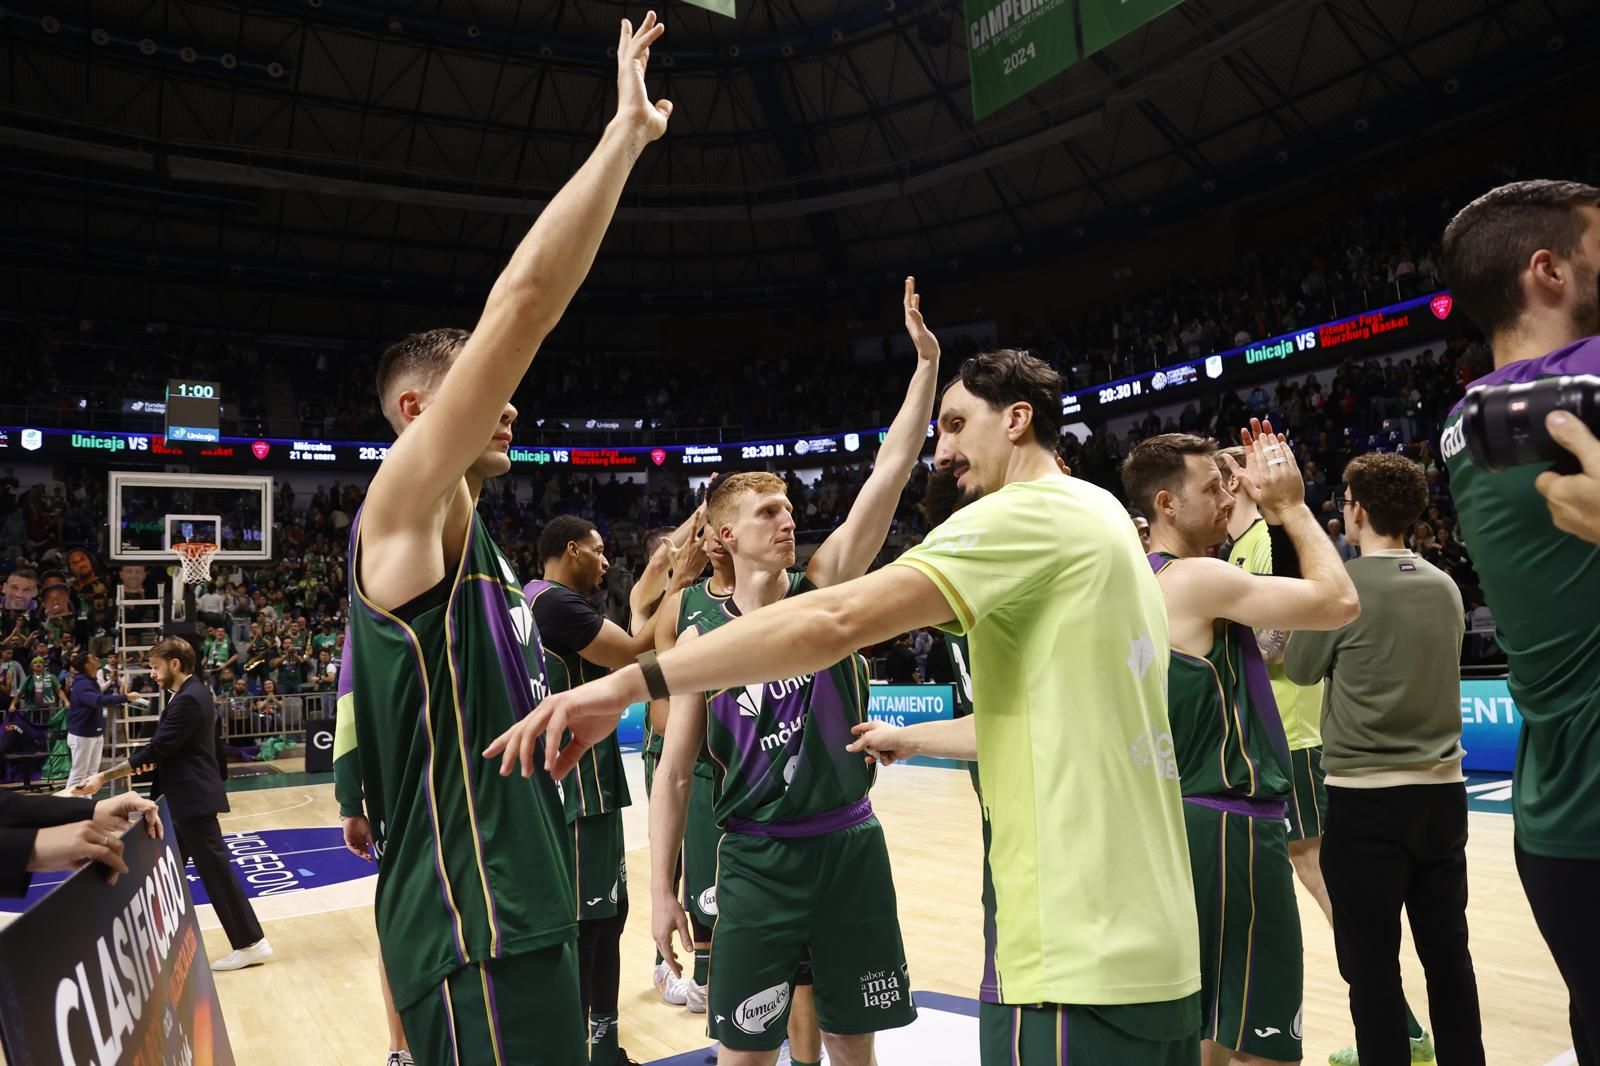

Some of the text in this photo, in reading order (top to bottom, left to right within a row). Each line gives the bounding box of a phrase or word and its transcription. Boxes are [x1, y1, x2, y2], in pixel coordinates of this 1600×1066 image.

[970, 0, 1051, 50] CAMPEO
[1002, 41, 1036, 76] 2024
[1372, 316, 1409, 335] Basket
[1245, 331, 1316, 365] Unicaja VS
[178, 383, 214, 397] 1:00
[1099, 384, 1132, 404] 20:30
[71, 434, 125, 452] Unicaja
[128, 436, 148, 450] VS
[187, 432, 214, 442] Unicaja
[359, 447, 390, 460] 20:3
[510, 449, 569, 465] Unicaja VS
[742, 445, 774, 459] 20:30
[56, 845, 186, 1066] CLASIFICADO
[859, 970, 886, 982] sabor
[867, 970, 900, 993] má
[862, 989, 902, 1010] laga
